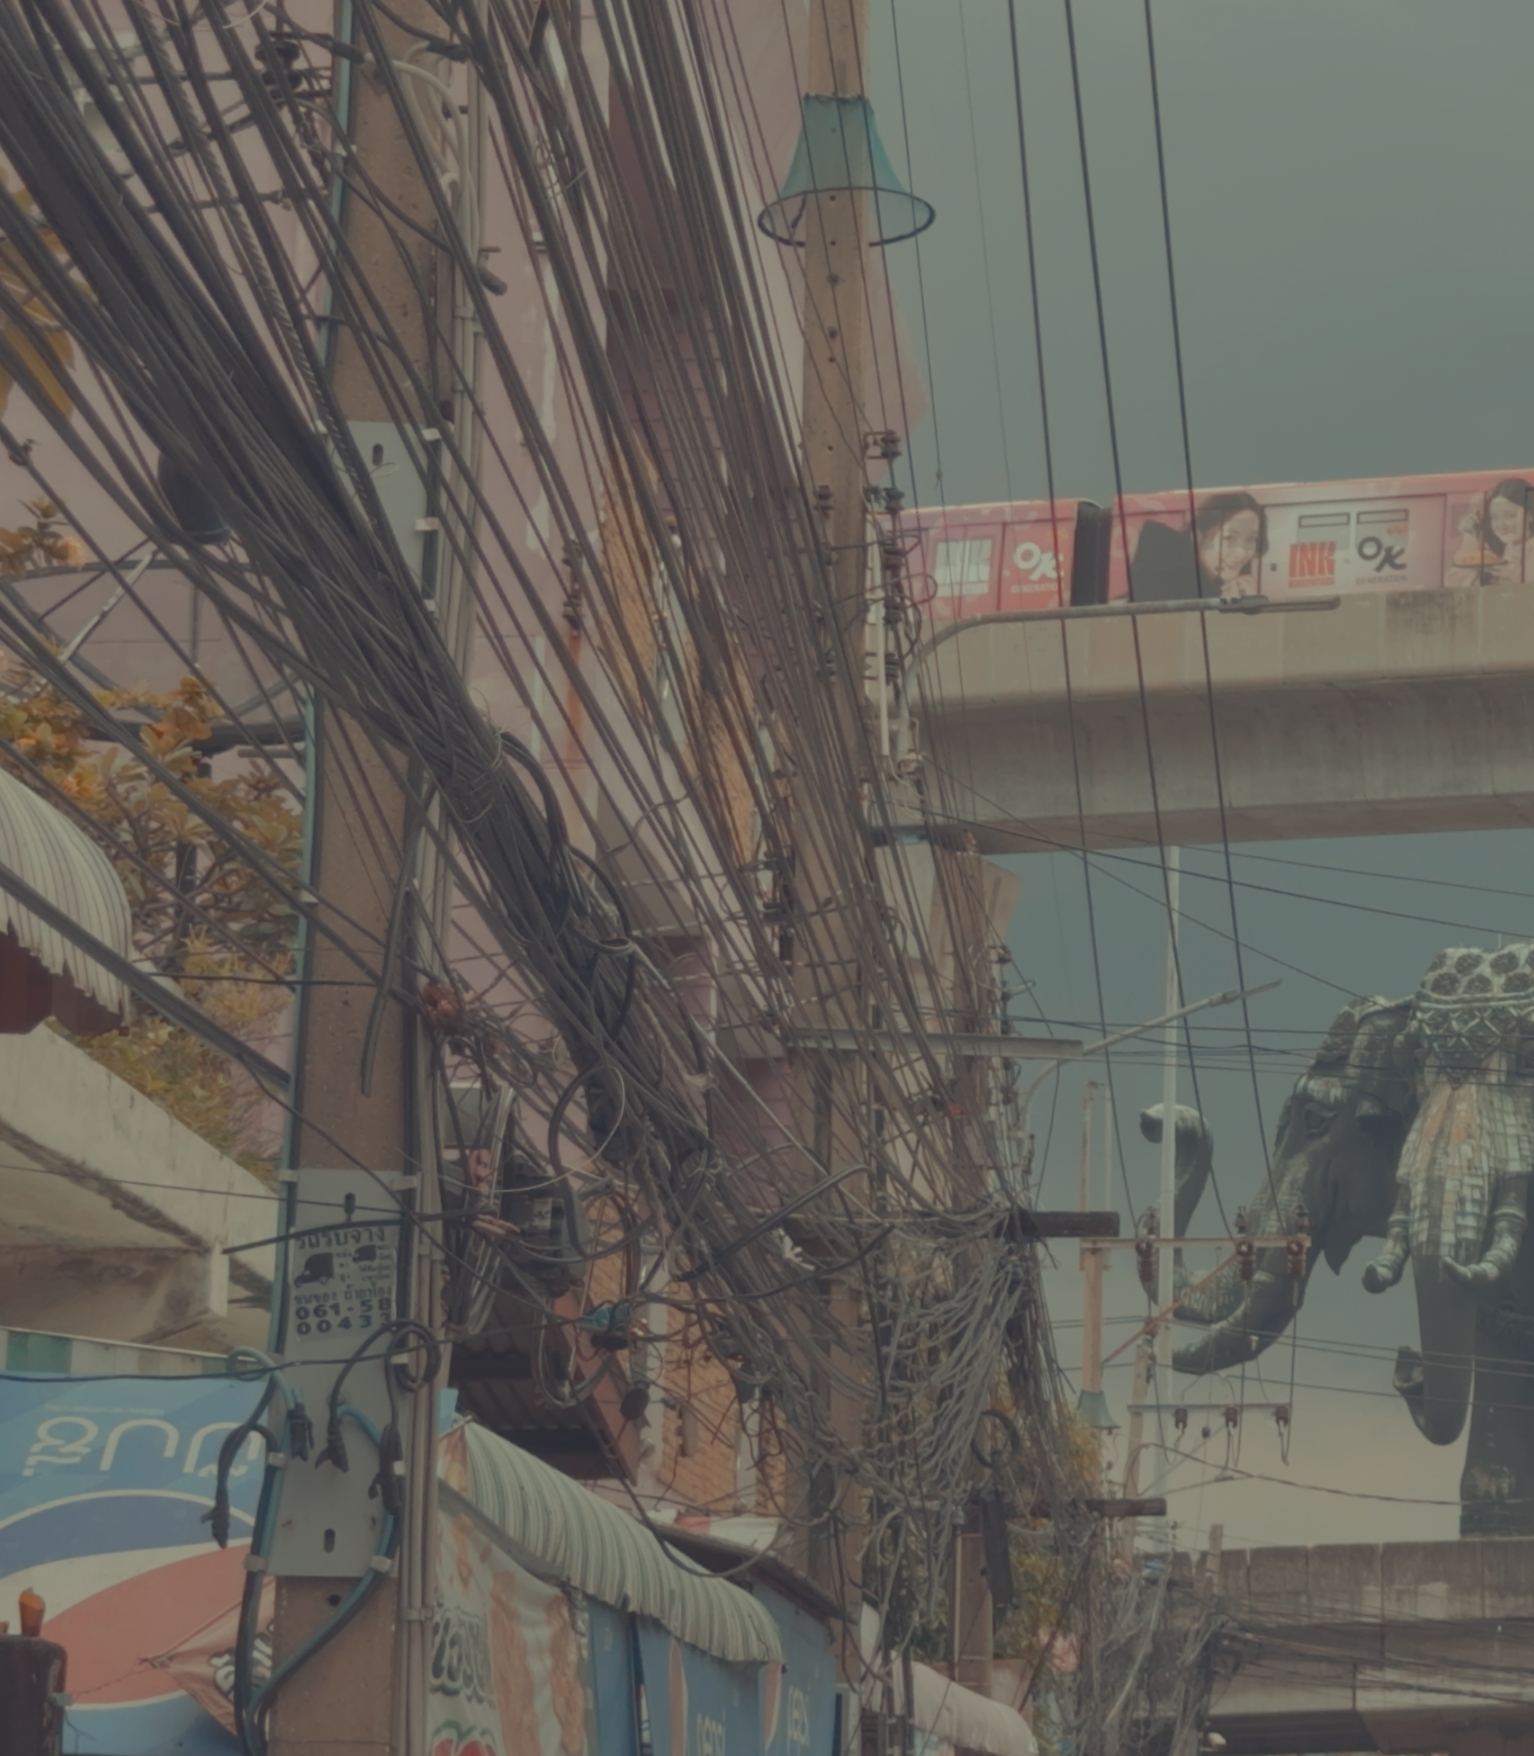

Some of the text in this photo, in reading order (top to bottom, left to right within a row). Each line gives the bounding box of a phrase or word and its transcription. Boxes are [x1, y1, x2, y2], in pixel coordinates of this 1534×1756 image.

[1289, 541, 1336, 578] INK
[296, 1226, 386, 1249] รถรบจาง
[22, 1415, 263, 1478] ป๊ปซี่
